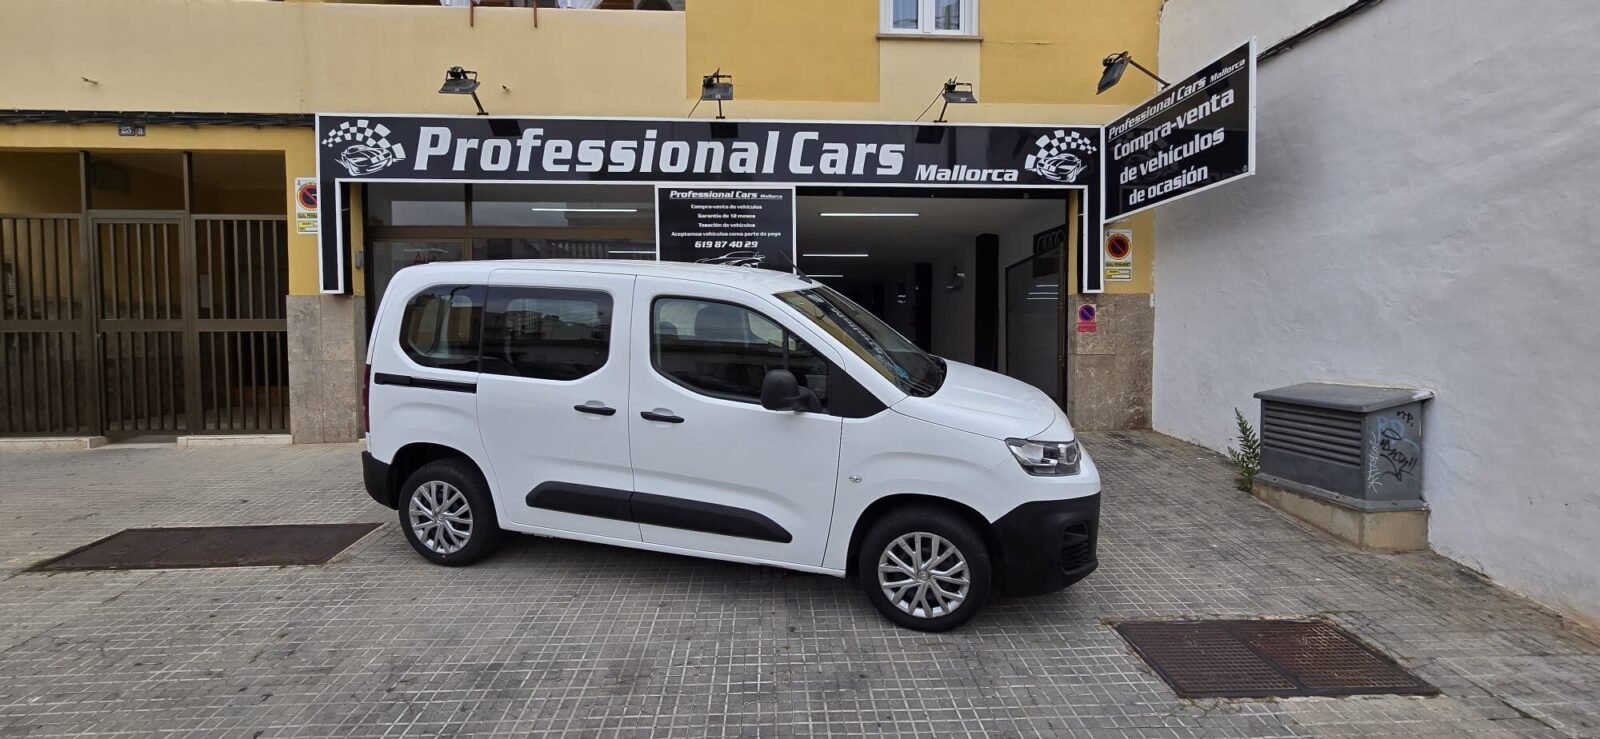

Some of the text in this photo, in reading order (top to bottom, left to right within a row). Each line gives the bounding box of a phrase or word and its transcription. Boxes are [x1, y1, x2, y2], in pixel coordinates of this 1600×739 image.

[1108, 58, 1246, 140] Professional Cars Mallorca
[1113, 88, 1235, 160] Compra-venta
[413, 126, 1019, 182] Professional Cars Mallorca
[1120, 127, 1225, 185] de vehículos
[670, 190, 734, 199] Professional
[735, 190, 758, 198] Cars
[1129, 165, 1209, 206] de ocasión
[694, 240, 759, 248] 619 87 40 29
